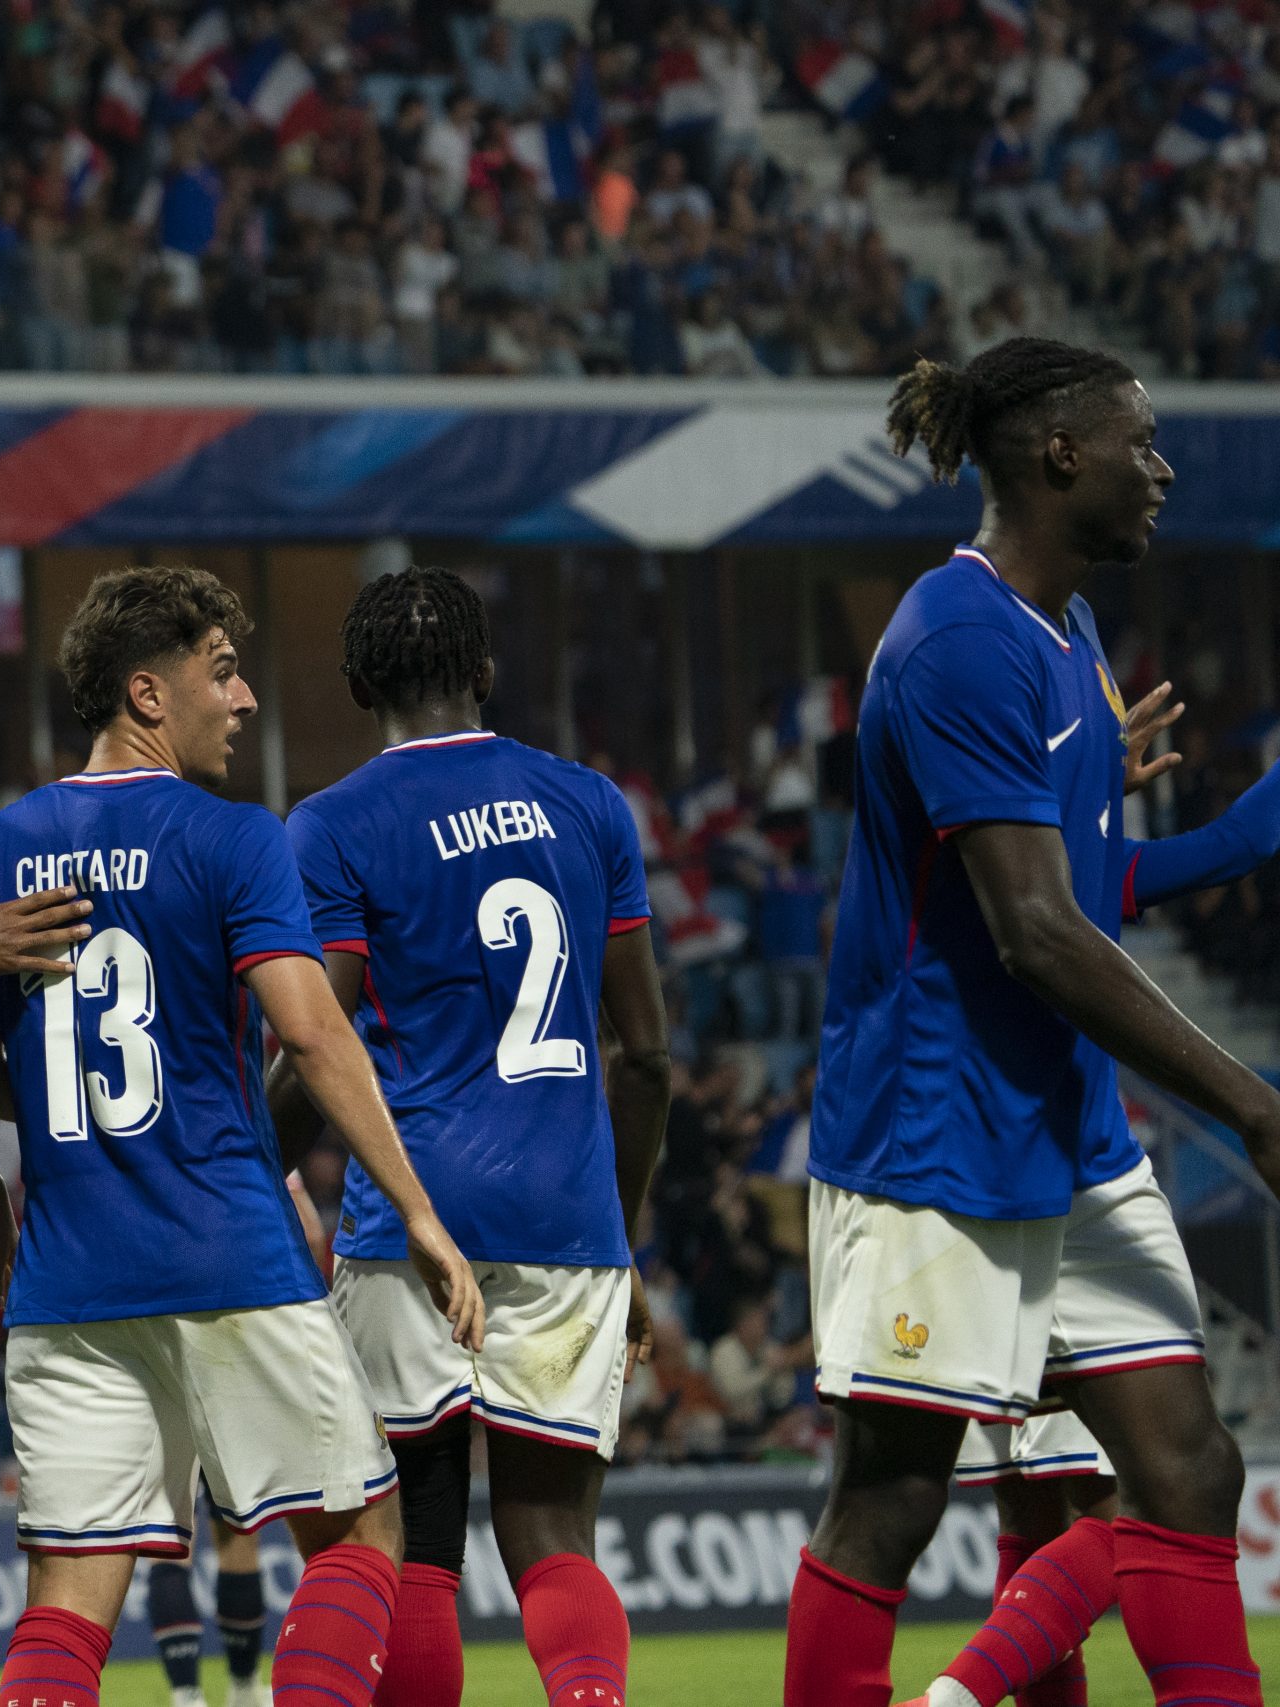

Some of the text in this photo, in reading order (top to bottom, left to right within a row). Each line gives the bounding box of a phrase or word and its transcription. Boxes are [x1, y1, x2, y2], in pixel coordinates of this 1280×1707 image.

[16, 848, 148, 898] CHOTARD
[429, 801, 556, 860] LUKEBA
[22, 927, 163, 1142] 13
[477, 877, 586, 1083] 2
